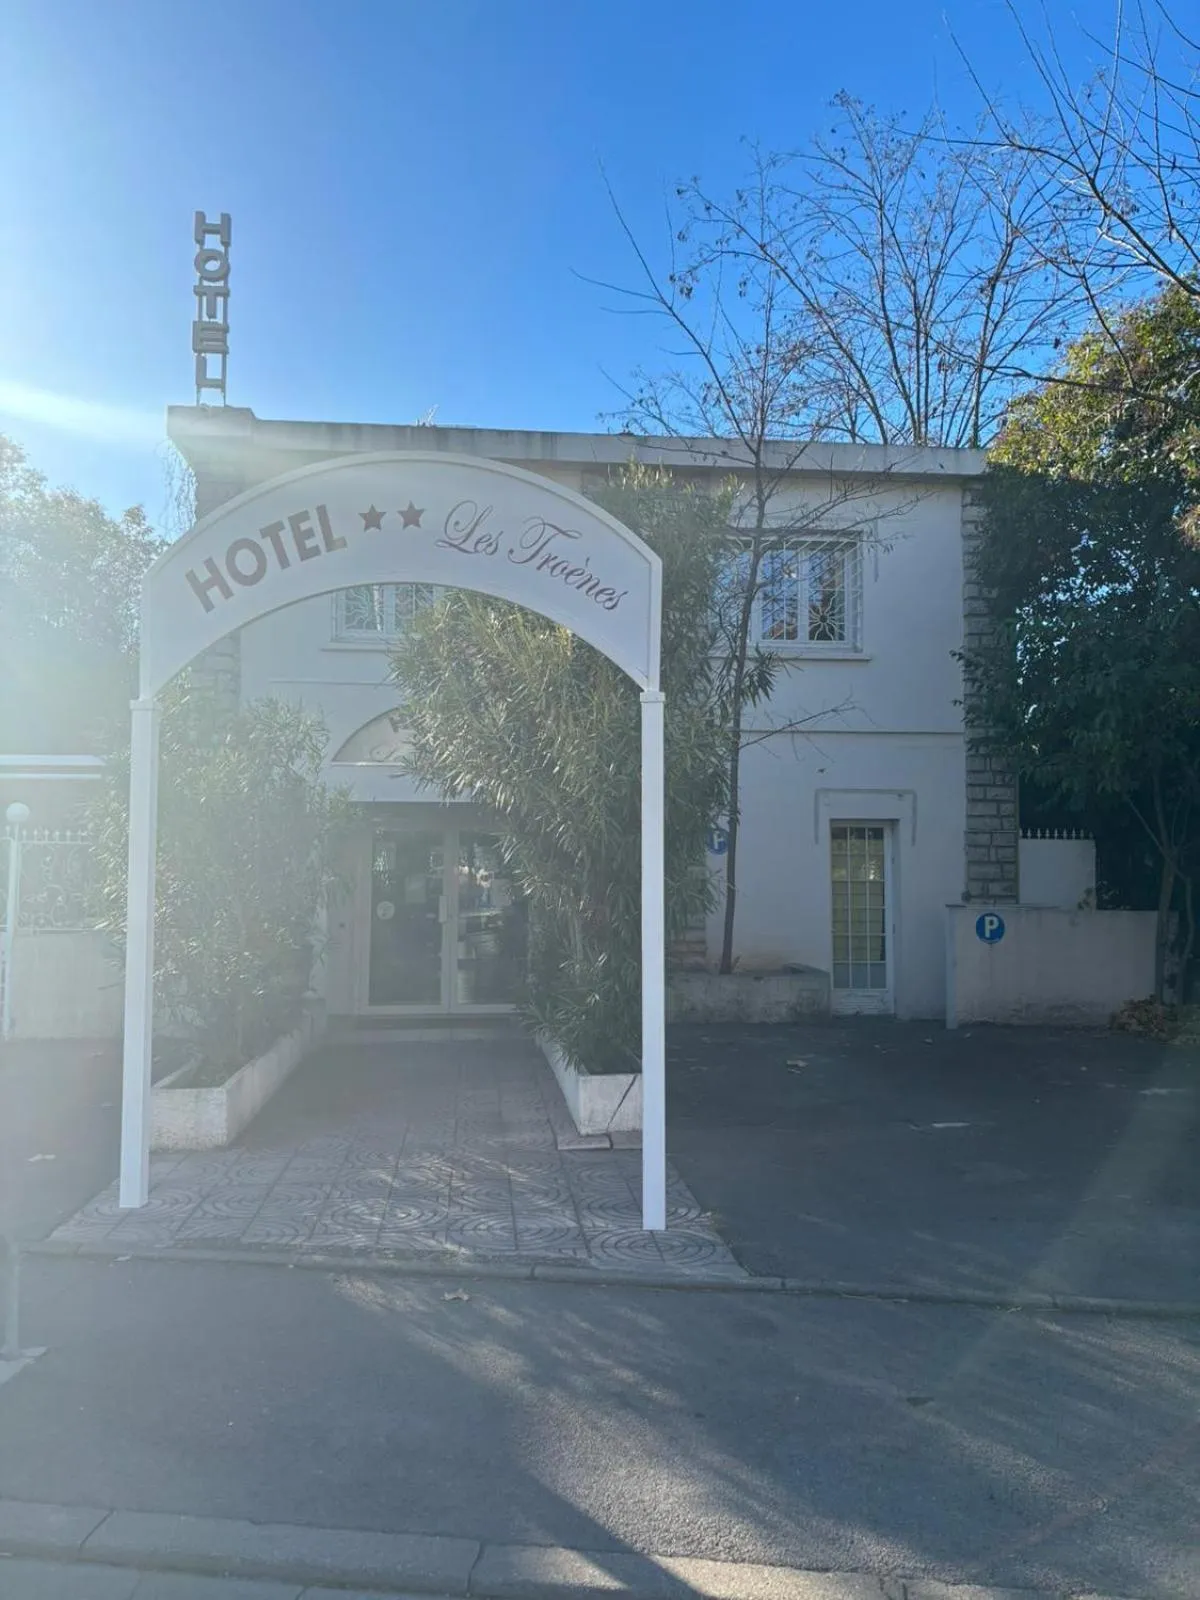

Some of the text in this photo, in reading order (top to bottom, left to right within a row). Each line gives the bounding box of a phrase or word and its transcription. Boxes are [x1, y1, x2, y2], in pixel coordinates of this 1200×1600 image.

[193, 211, 231, 388] HOTEL
[186, 500, 630, 614] HOTEL Les Troènes
[984, 915, 1000, 938] P
